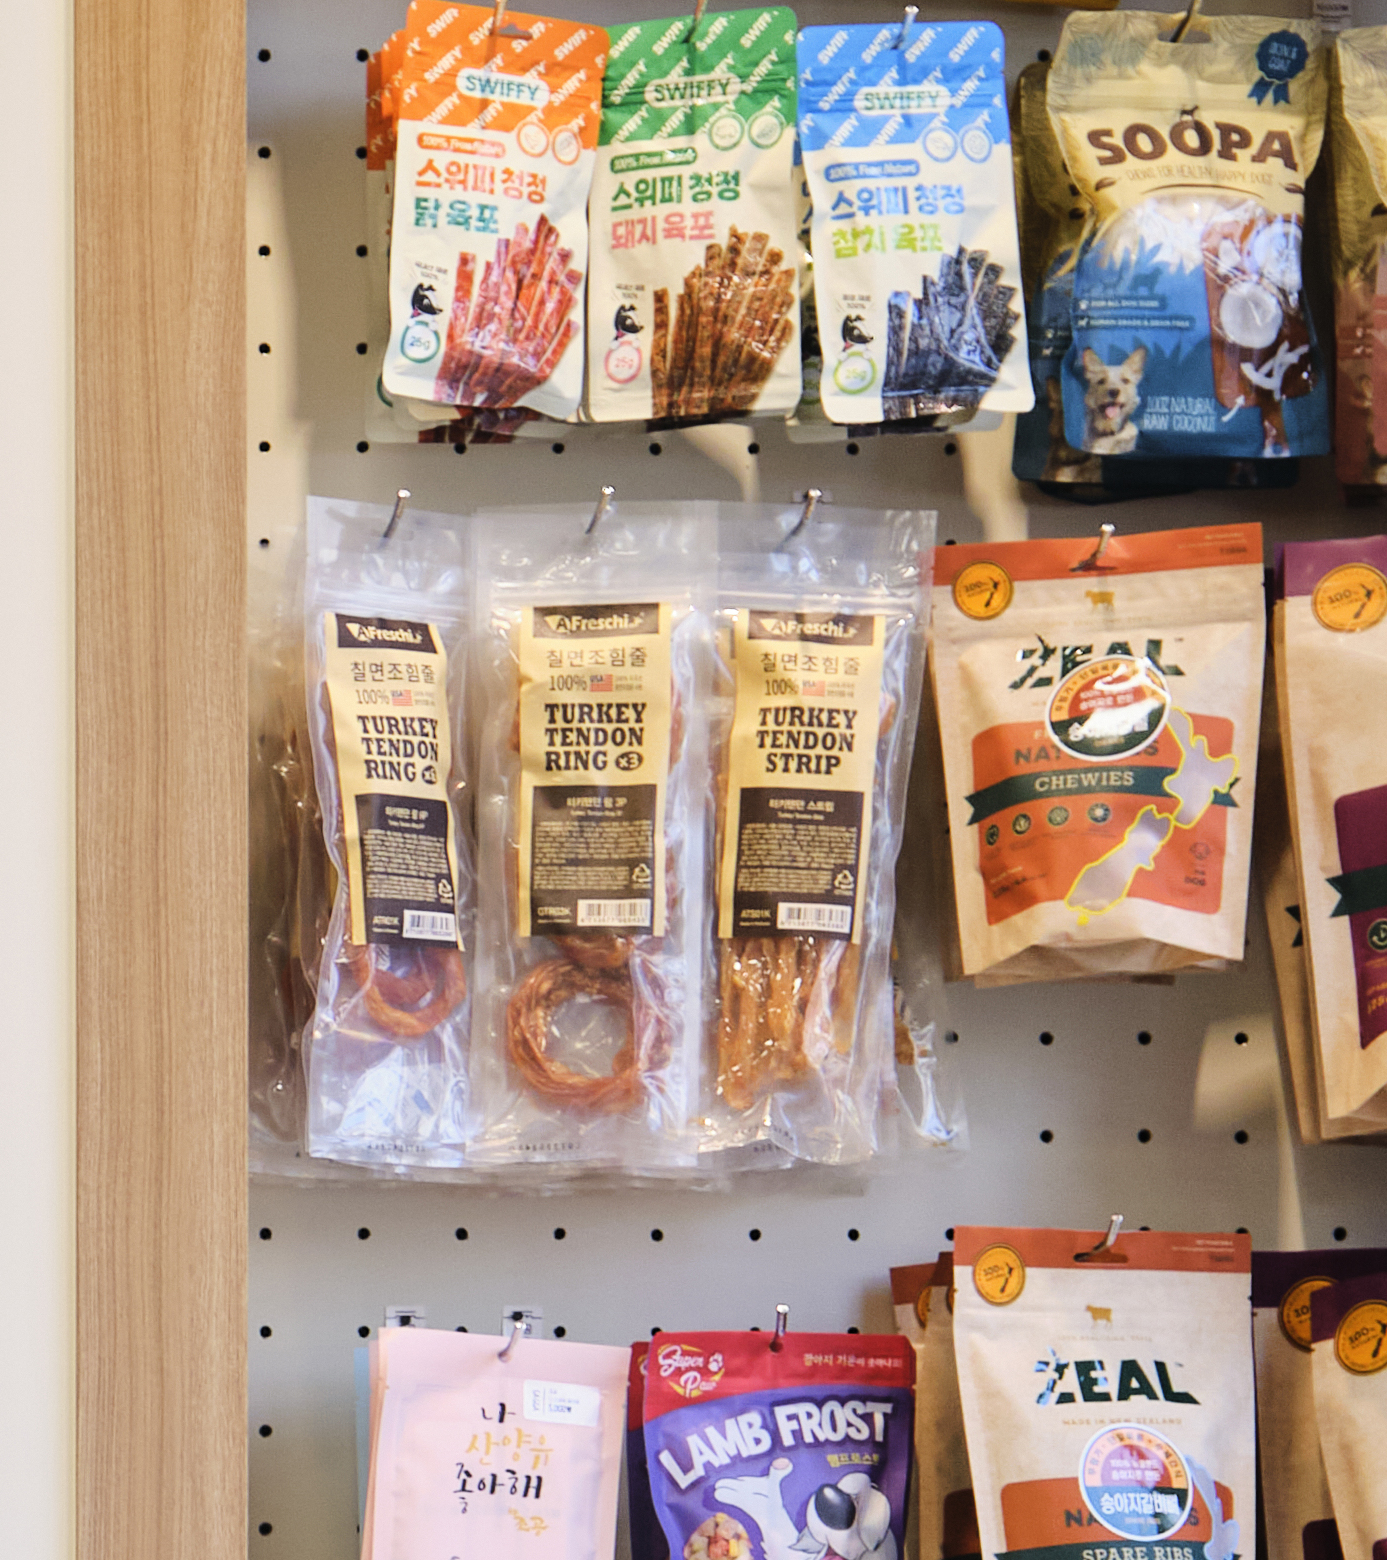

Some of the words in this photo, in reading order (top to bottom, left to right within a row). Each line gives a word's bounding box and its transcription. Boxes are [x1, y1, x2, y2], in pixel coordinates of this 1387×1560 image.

[465, 73, 540, 101] SWIFFY
[654, 78, 728, 102] SWIFFY
[865, 91, 940, 111] SWIFFY
[1087, 118, 1299, 172] SOOPA
[415, 157, 495, 195] 스위피
[502, 168, 547, 204] 청정
[611, 174, 682, 212] 스위피
[689, 170, 740, 204] 청정
[830, 186, 909, 222] 스위피
[915, 183, 965, 215] 청정
[414, 197, 438, 229] 닭
[447, 201, 499, 233] 육포
[611, 216, 657, 250] 돼지
[662, 210, 714, 242] 육포
[832, 226, 887, 259] 참치
[892, 223, 944, 254] 육포
[1143, 414, 1169, 430] RAW
[546, 647, 648, 668] 칠면조힘줄
[760, 652, 861, 676] 칠면조힘줄
[350, 661, 436, 684] 칠면조힘줄
[549, 674, 587, 692] 100%
[354, 689, 390, 706] 100%
[765, 678, 799, 697] 100%
[544, 702, 646, 724] TURKEY
[759, 707, 858, 730] TURKEY
[357, 715, 438, 739] TURKEY
[545, 726, 644, 747] TENDON
[362, 737, 438, 762] TENDON
[756, 730, 855, 752] TENDON
[363, 759, 415, 782] RING
[545, 751, 608, 771] RING
[766, 753, 842, 776] STRIP
[1034, 771, 1134, 792] CHEWIES
[1034, 1345, 1201, 1407] ZEAL
[481, 1402, 516, 1423] 나
[465, 1427, 554, 1470] 산양유
[659, 1410, 772, 1491] LAMB
[774, 1400, 893, 1447] FROST
[453, 1462, 543, 1514] 좋아해
